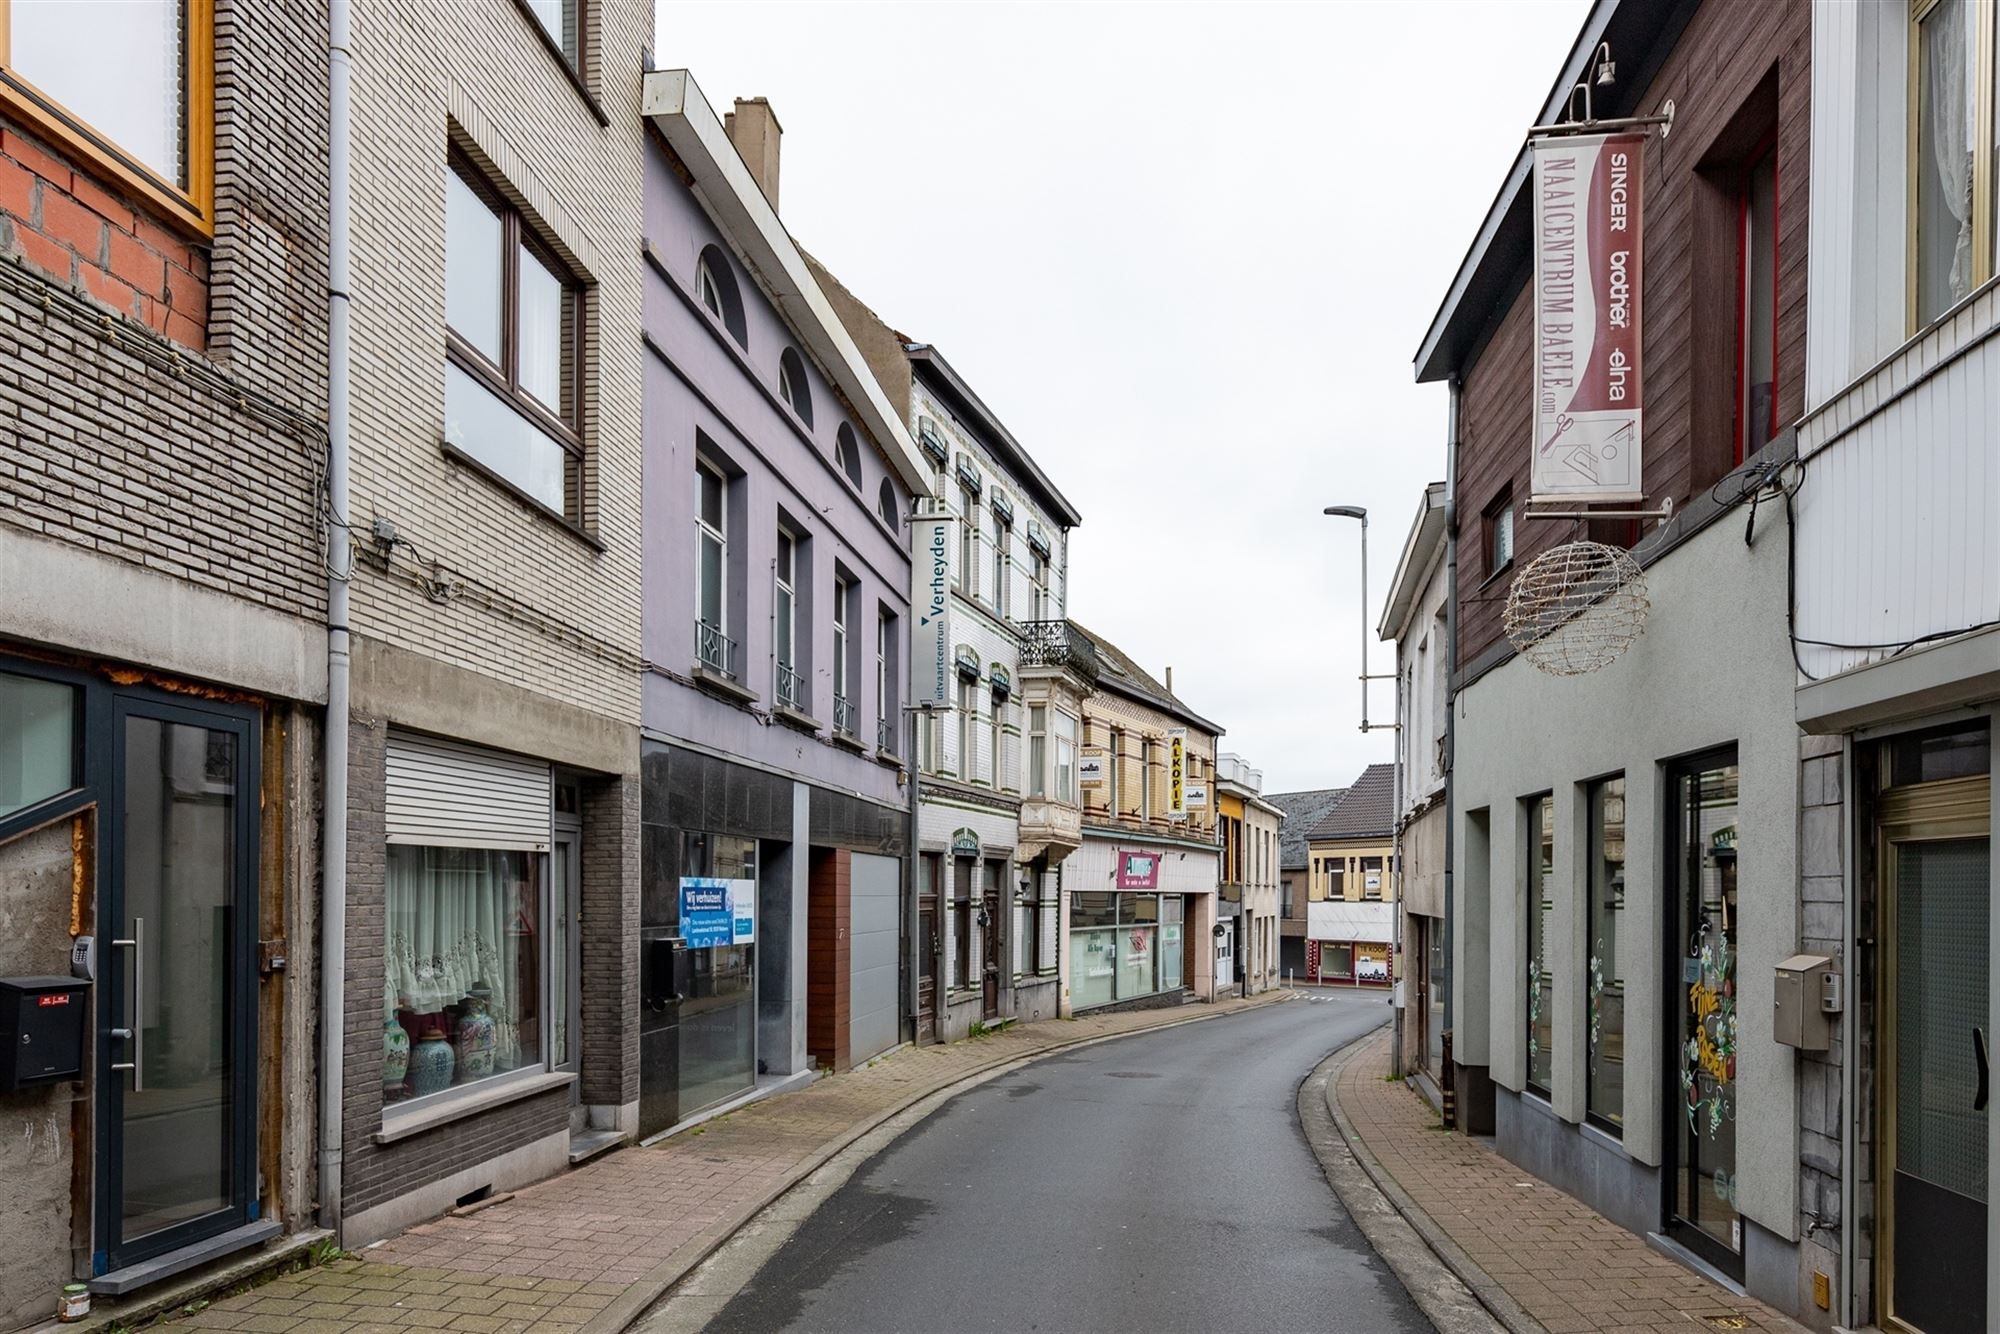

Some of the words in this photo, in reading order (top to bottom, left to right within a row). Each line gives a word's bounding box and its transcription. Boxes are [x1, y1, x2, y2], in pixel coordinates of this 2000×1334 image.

[1610, 152, 1628, 232] SINGER
[1543, 157, 1576, 317] NAAICENTRUM
[1609, 250, 1630, 329] brother
[1540, 320, 1574, 414] BAELE.com
[1608, 348, 1631, 401] elna
[930, 526, 948, 617] Verheyden
[933, 620, 945, 701] uitvaartcentrum
[1172, 737, 1181, 809] ALKOPIE
[685, 891, 695, 905] Wij
[1368, 945, 1386, 953] KOOP
